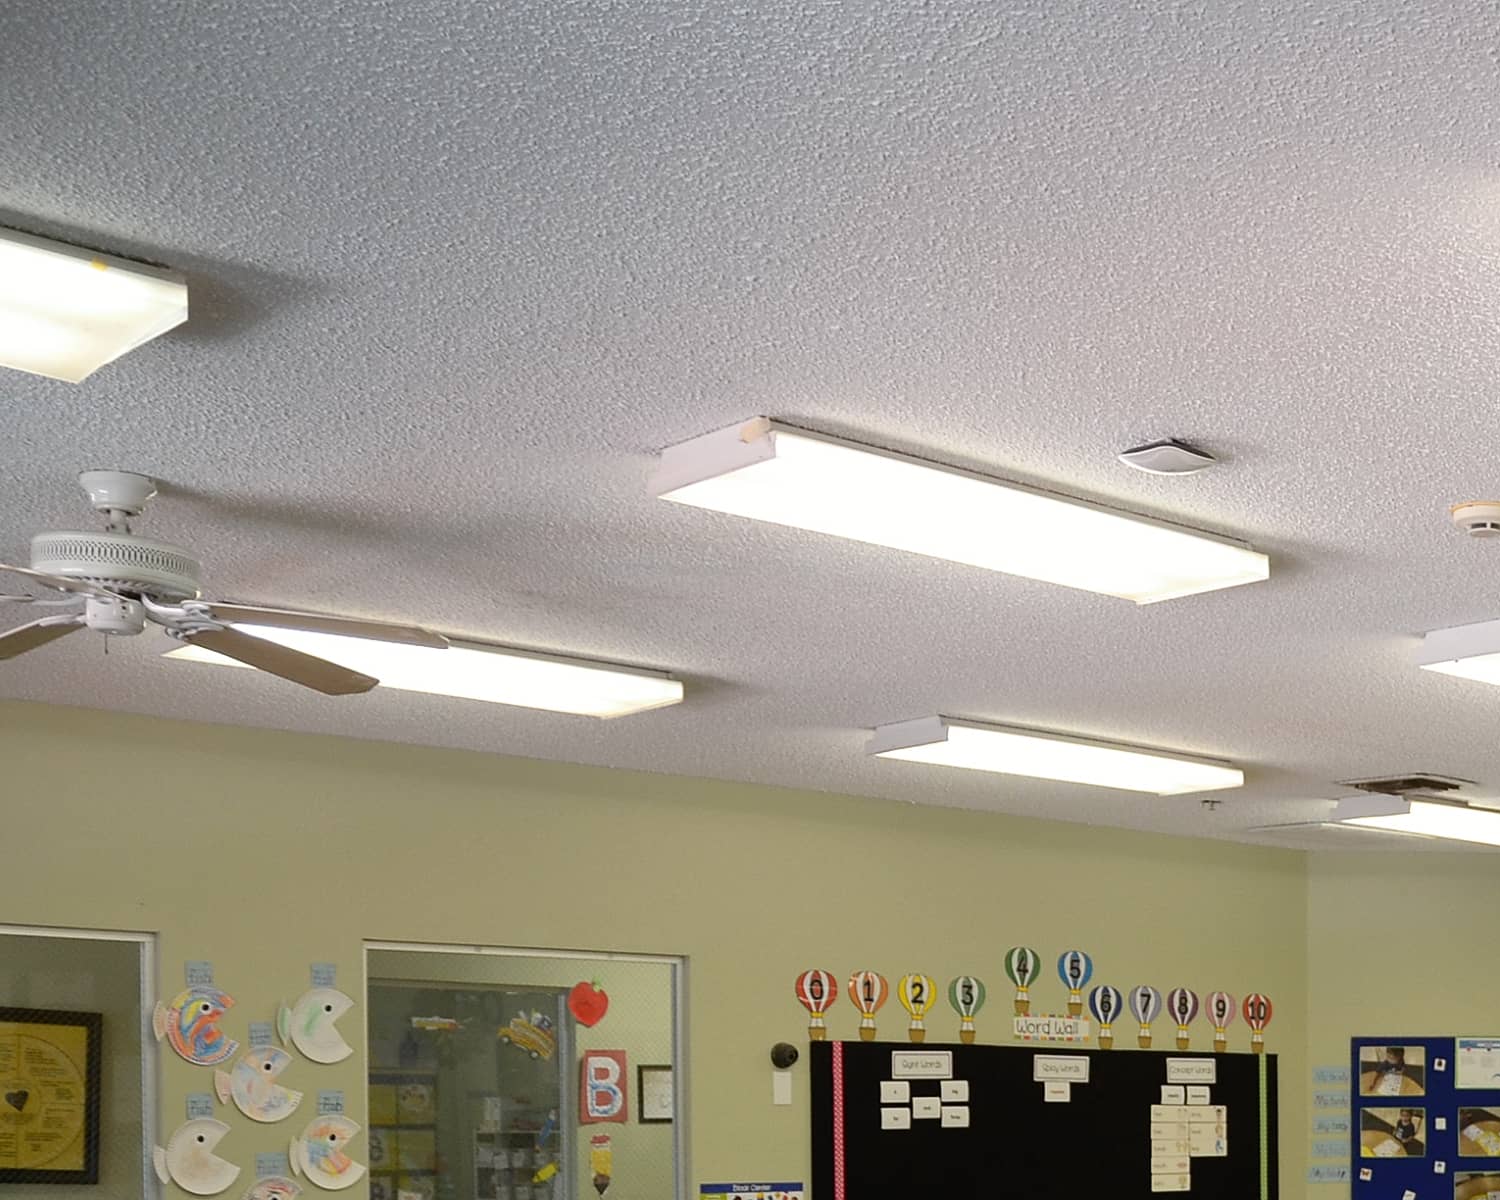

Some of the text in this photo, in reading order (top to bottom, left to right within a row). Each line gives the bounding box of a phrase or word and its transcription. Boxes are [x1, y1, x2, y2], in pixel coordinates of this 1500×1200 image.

[1016, 956, 1028, 976] 4
[1069, 959, 1080, 979] 5
[809, 979, 823, 1000] 0
[863, 980, 874, 1002] 1
[911, 983, 924, 1004] 2
[962, 984, 974, 1006] 3
[1100, 994, 1112, 1013] 6
[1140, 994, 1151, 1013] 7
[1178, 996, 1188, 1015] 8
[1215, 999, 1225, 1018] 9
[1249, 1001, 1265, 1020] 10
[1016, 1017, 1079, 1035] Word Wall
[587, 1056, 623, 1117] B
